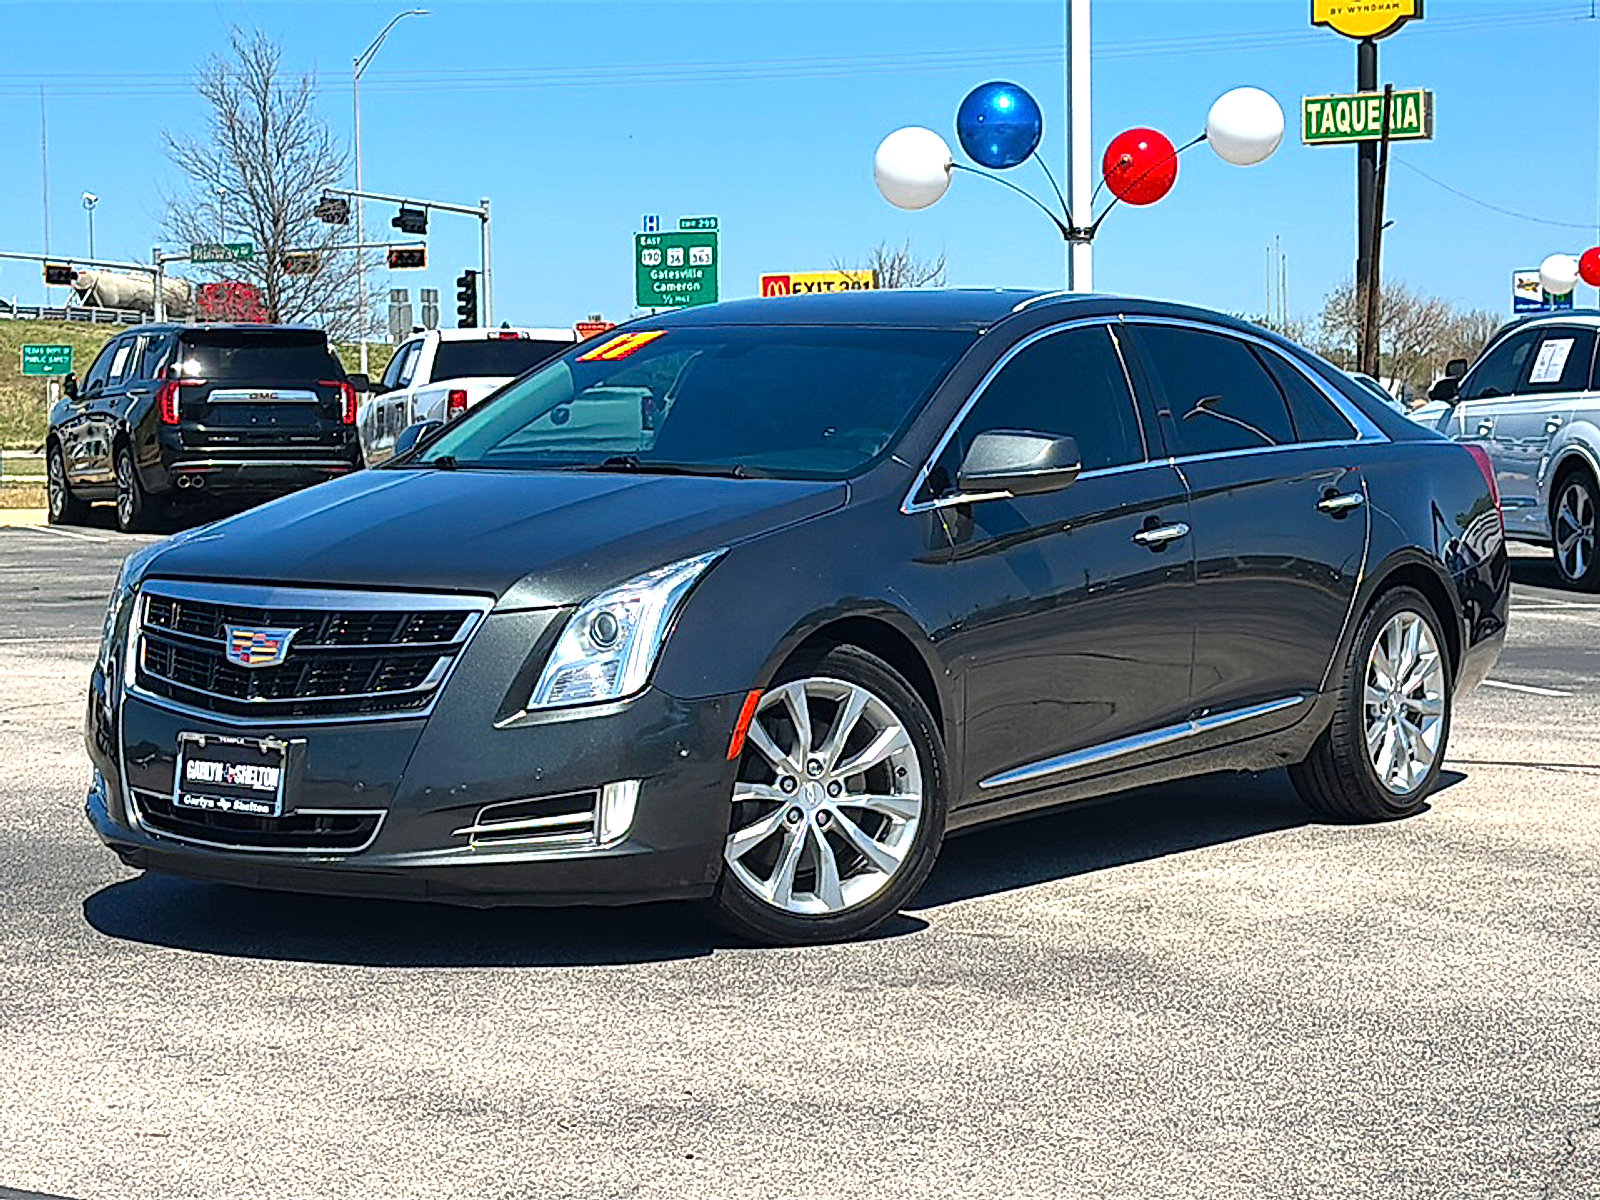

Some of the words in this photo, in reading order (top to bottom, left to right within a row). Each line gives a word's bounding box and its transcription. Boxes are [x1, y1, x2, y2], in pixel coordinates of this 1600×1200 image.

[1347, 3, 1400, 13] WYNDHAM
[650, 269, 703, 280] Gatesville
[653, 282, 701, 292] Cameron
[234, 765, 280, 787] SHELTON
